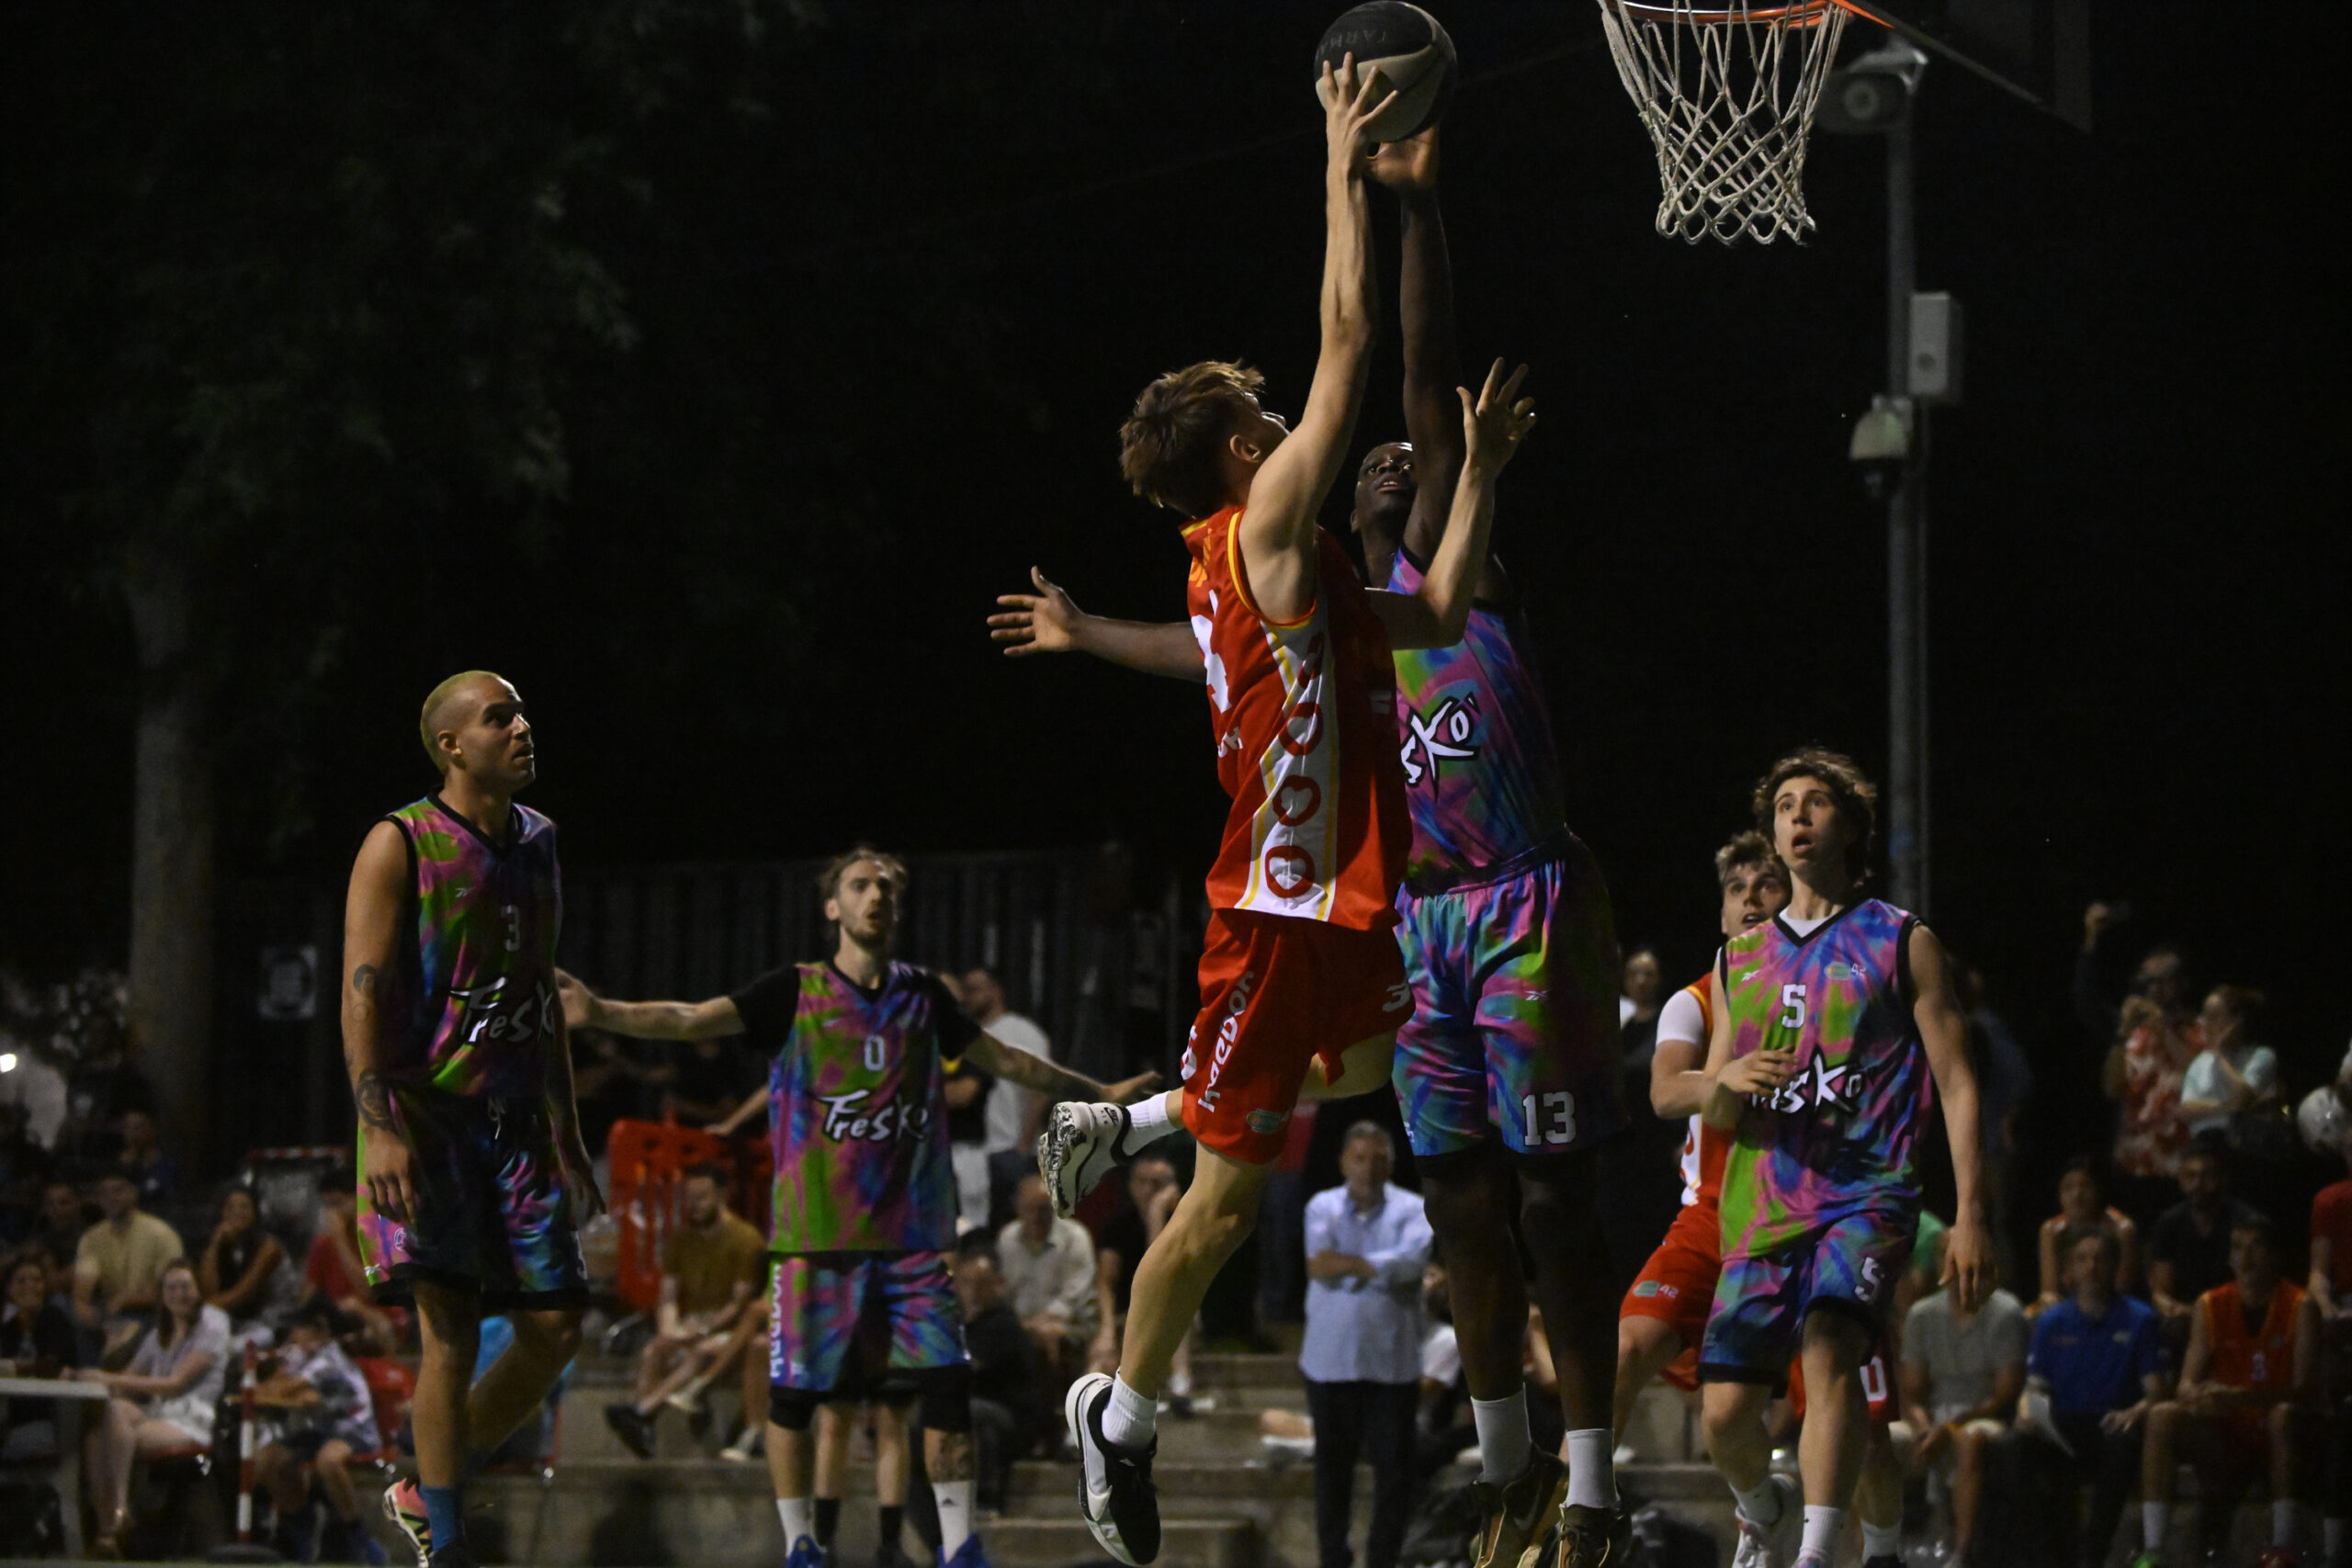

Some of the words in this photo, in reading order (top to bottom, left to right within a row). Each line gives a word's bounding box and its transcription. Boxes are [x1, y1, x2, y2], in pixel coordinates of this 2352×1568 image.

[502, 904, 521, 952] 3
[1781, 984, 1806, 1028] 5
[865, 1034, 886, 1072] 0
[1522, 1090, 1577, 1146] 13
[1854, 1257, 1885, 1305] 5
